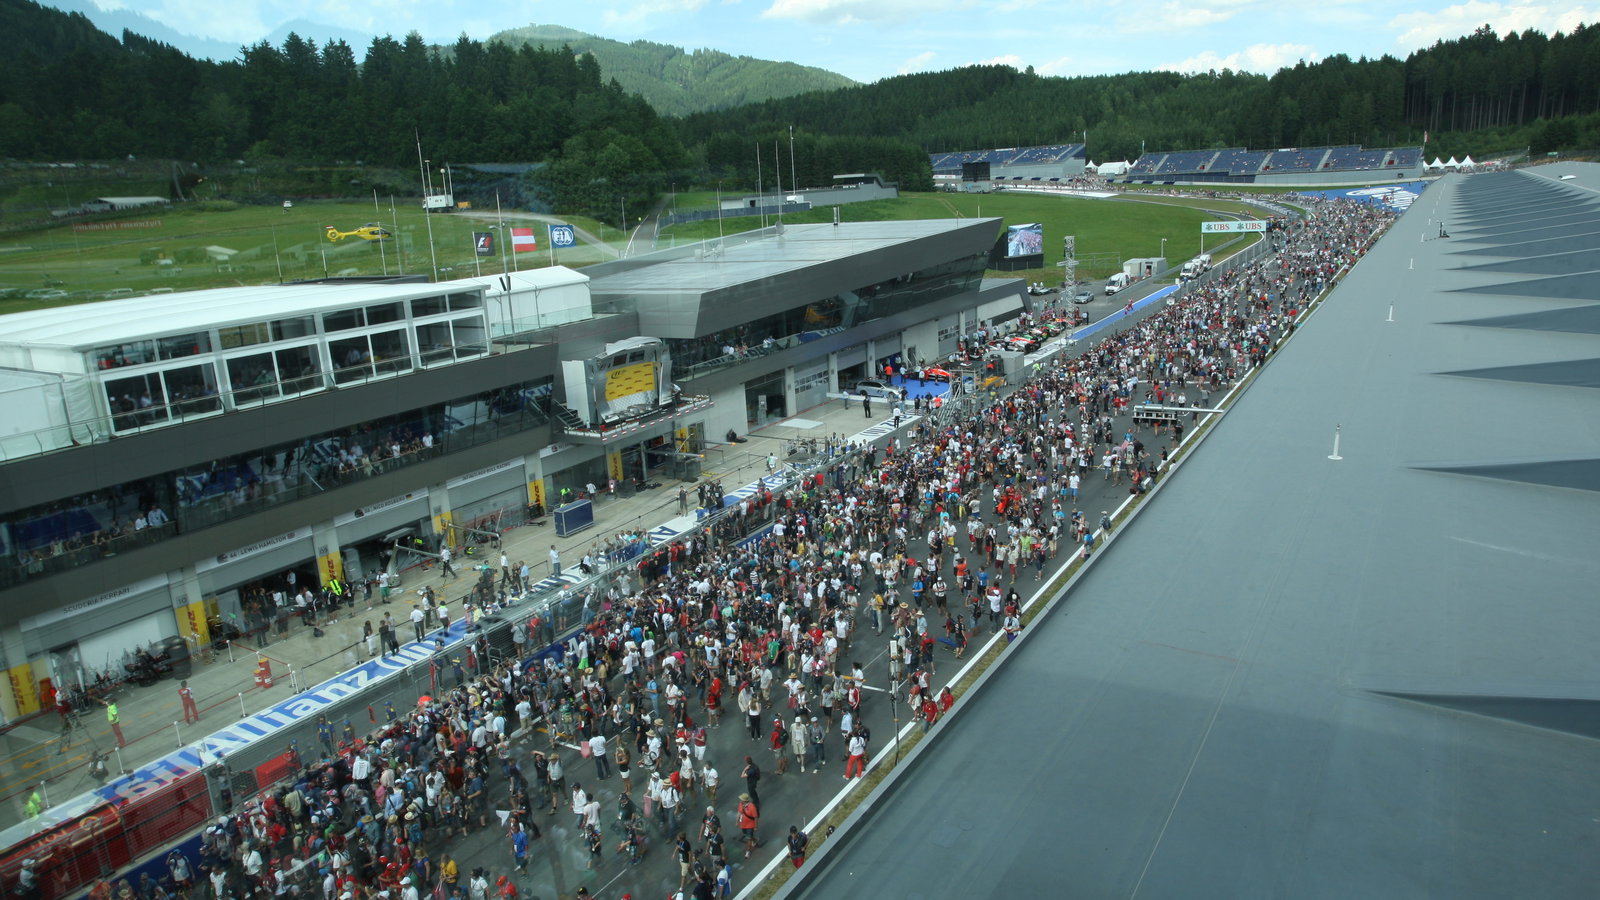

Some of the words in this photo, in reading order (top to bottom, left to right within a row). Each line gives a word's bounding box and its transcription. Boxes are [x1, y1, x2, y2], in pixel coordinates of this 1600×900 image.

[552, 230, 572, 243] FIA
[1213, 223, 1230, 231] UBS
[240, 544, 258, 555] LEWIS
[259, 535, 287, 549] HAMILTON
[63, 599, 98, 613] SCUDERIA
[100, 588, 130, 602] FERRARI
[202, 668, 377, 768] Allianz
